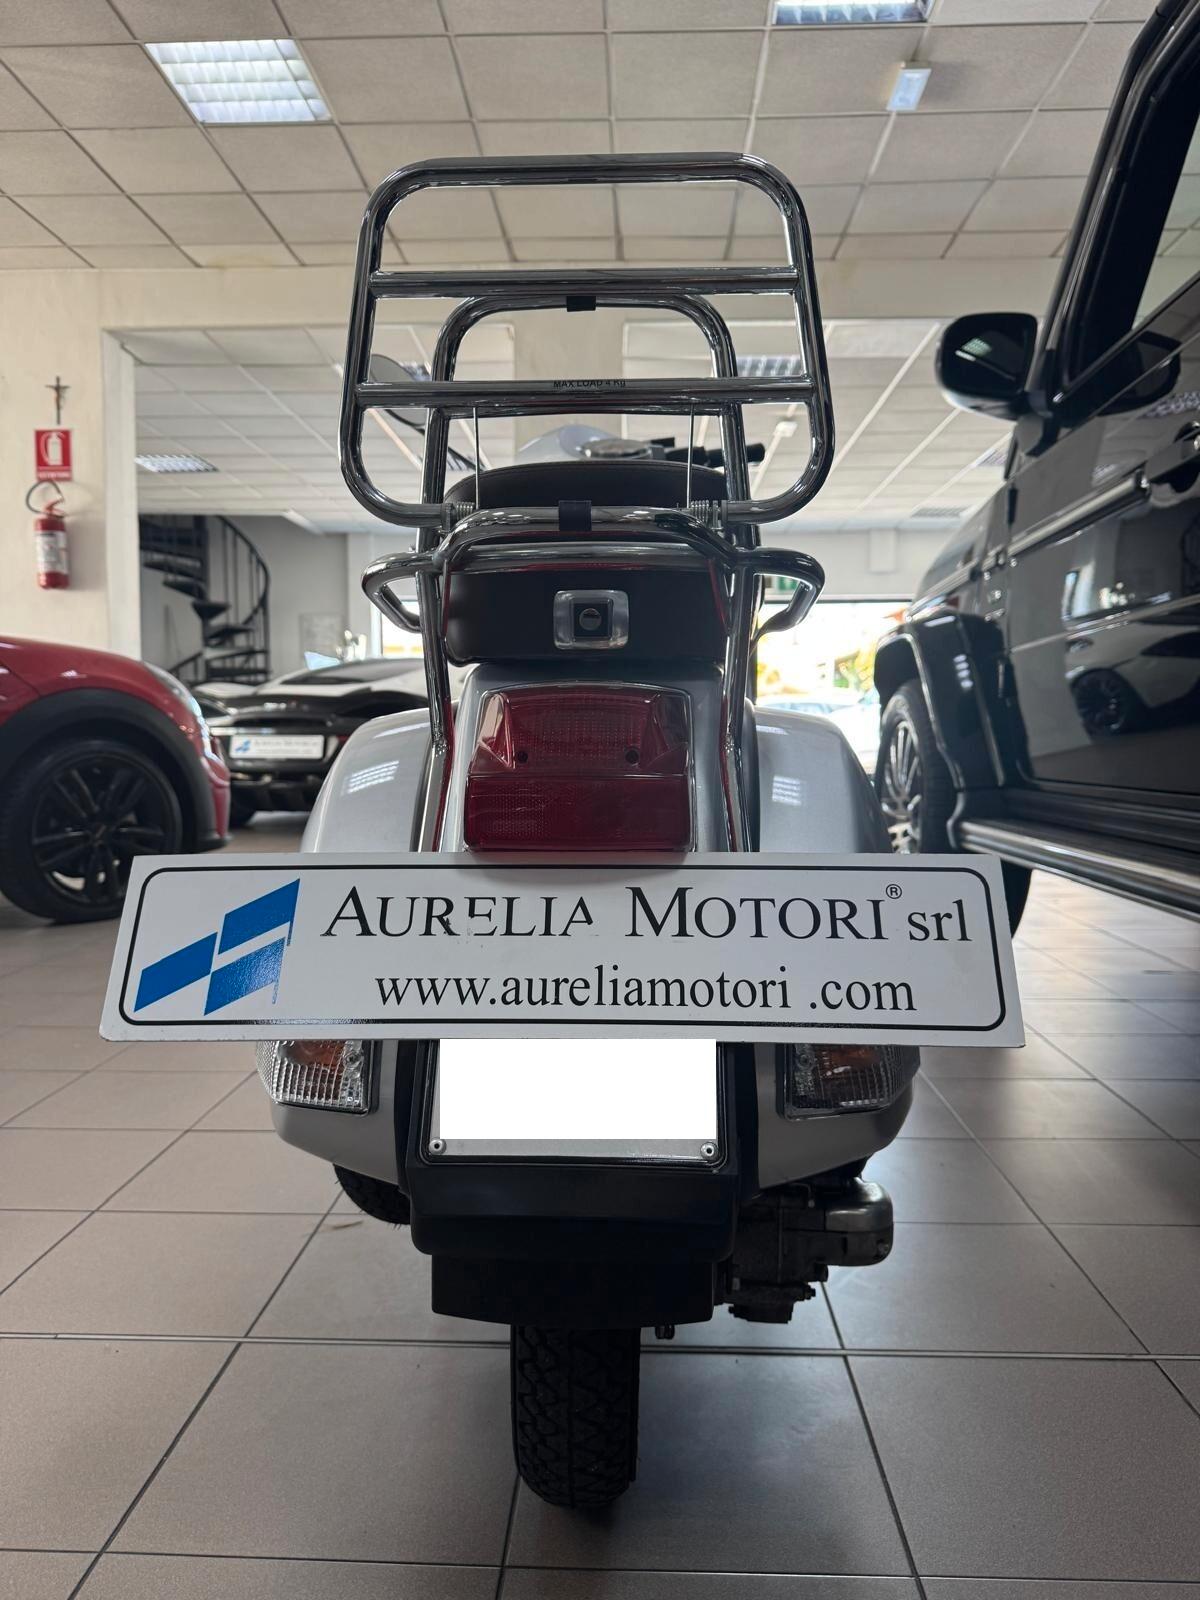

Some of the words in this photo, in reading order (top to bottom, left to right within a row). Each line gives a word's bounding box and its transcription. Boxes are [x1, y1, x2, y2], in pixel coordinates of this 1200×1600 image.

[553, 379, 574, 388] MAX
[576, 379, 603, 388] LOAD
[320, 886, 598, 938] AURELIA
[908, 899, 973, 942] srl
